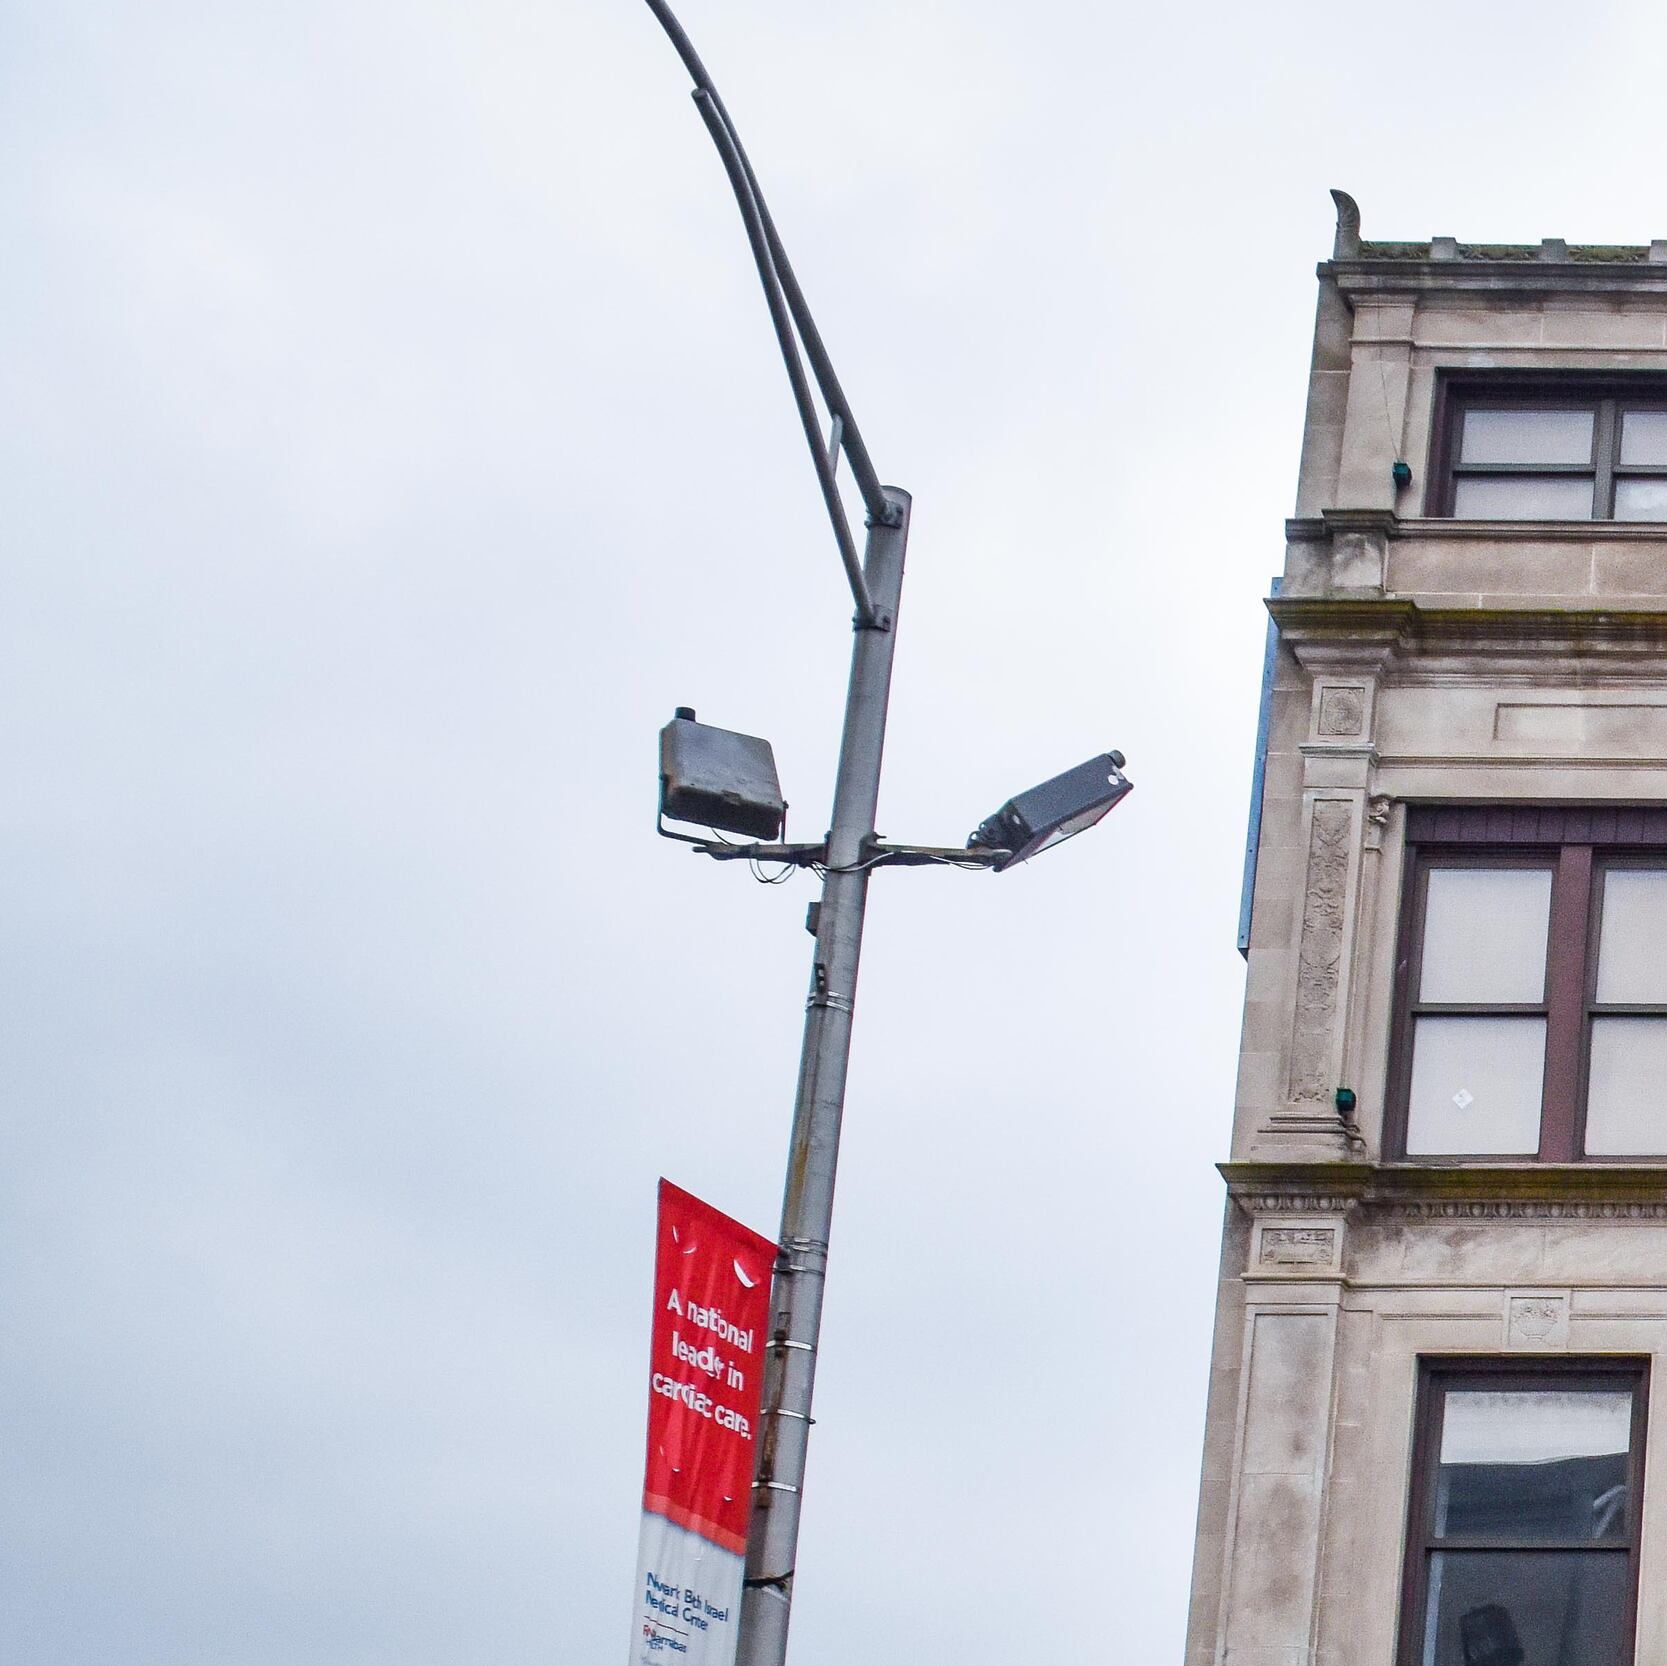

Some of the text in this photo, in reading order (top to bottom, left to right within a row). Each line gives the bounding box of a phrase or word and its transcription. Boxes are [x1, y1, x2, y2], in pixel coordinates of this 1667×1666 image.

[667, 1288, 683, 1316] A
[727, 1361, 744, 1392] in
[714, 1405, 752, 1441] care.
